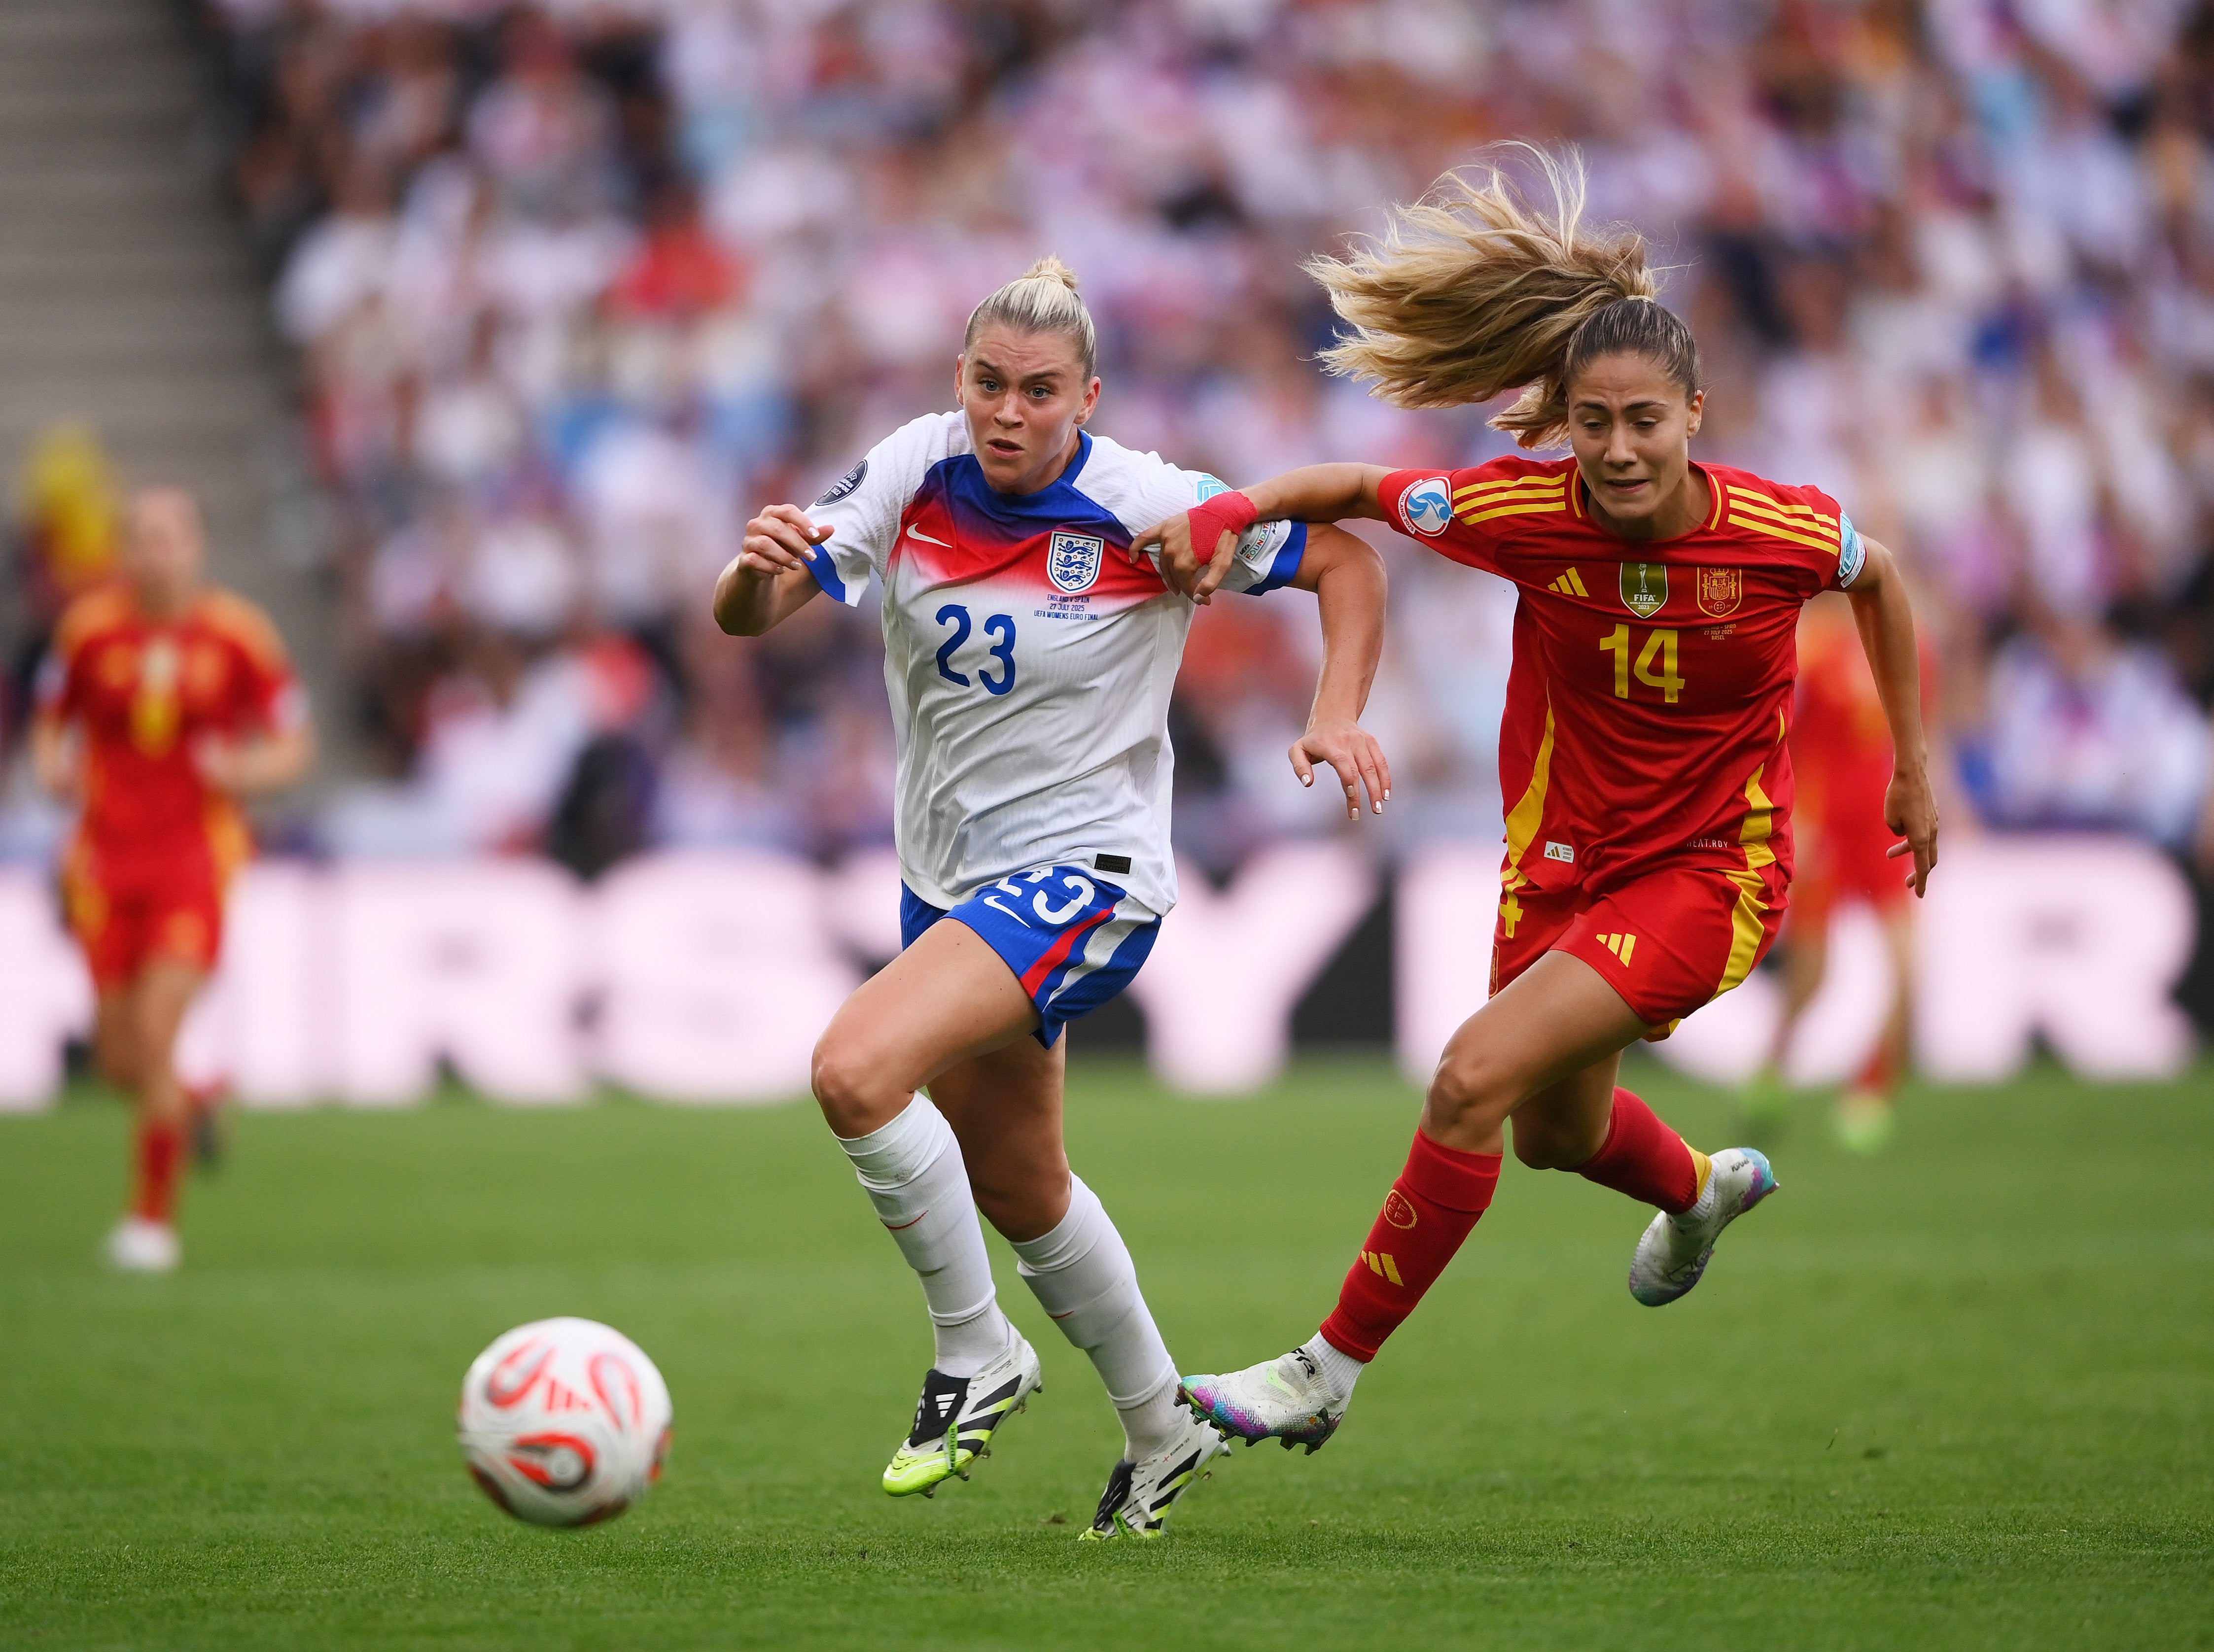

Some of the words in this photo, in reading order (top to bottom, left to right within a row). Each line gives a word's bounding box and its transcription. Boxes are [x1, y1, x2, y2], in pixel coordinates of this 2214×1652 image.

[1399, 481, 1420, 517] SWITZERLAND
[1404, 518, 1414, 532] 2025
[1239, 544, 1251, 555] UEFA
[1047, 594, 1069, 603] ENGLAND
[1047, 611, 1068, 620] WOMENS
[936, 604, 1016, 695] 23
[1600, 623, 1686, 703] 14
